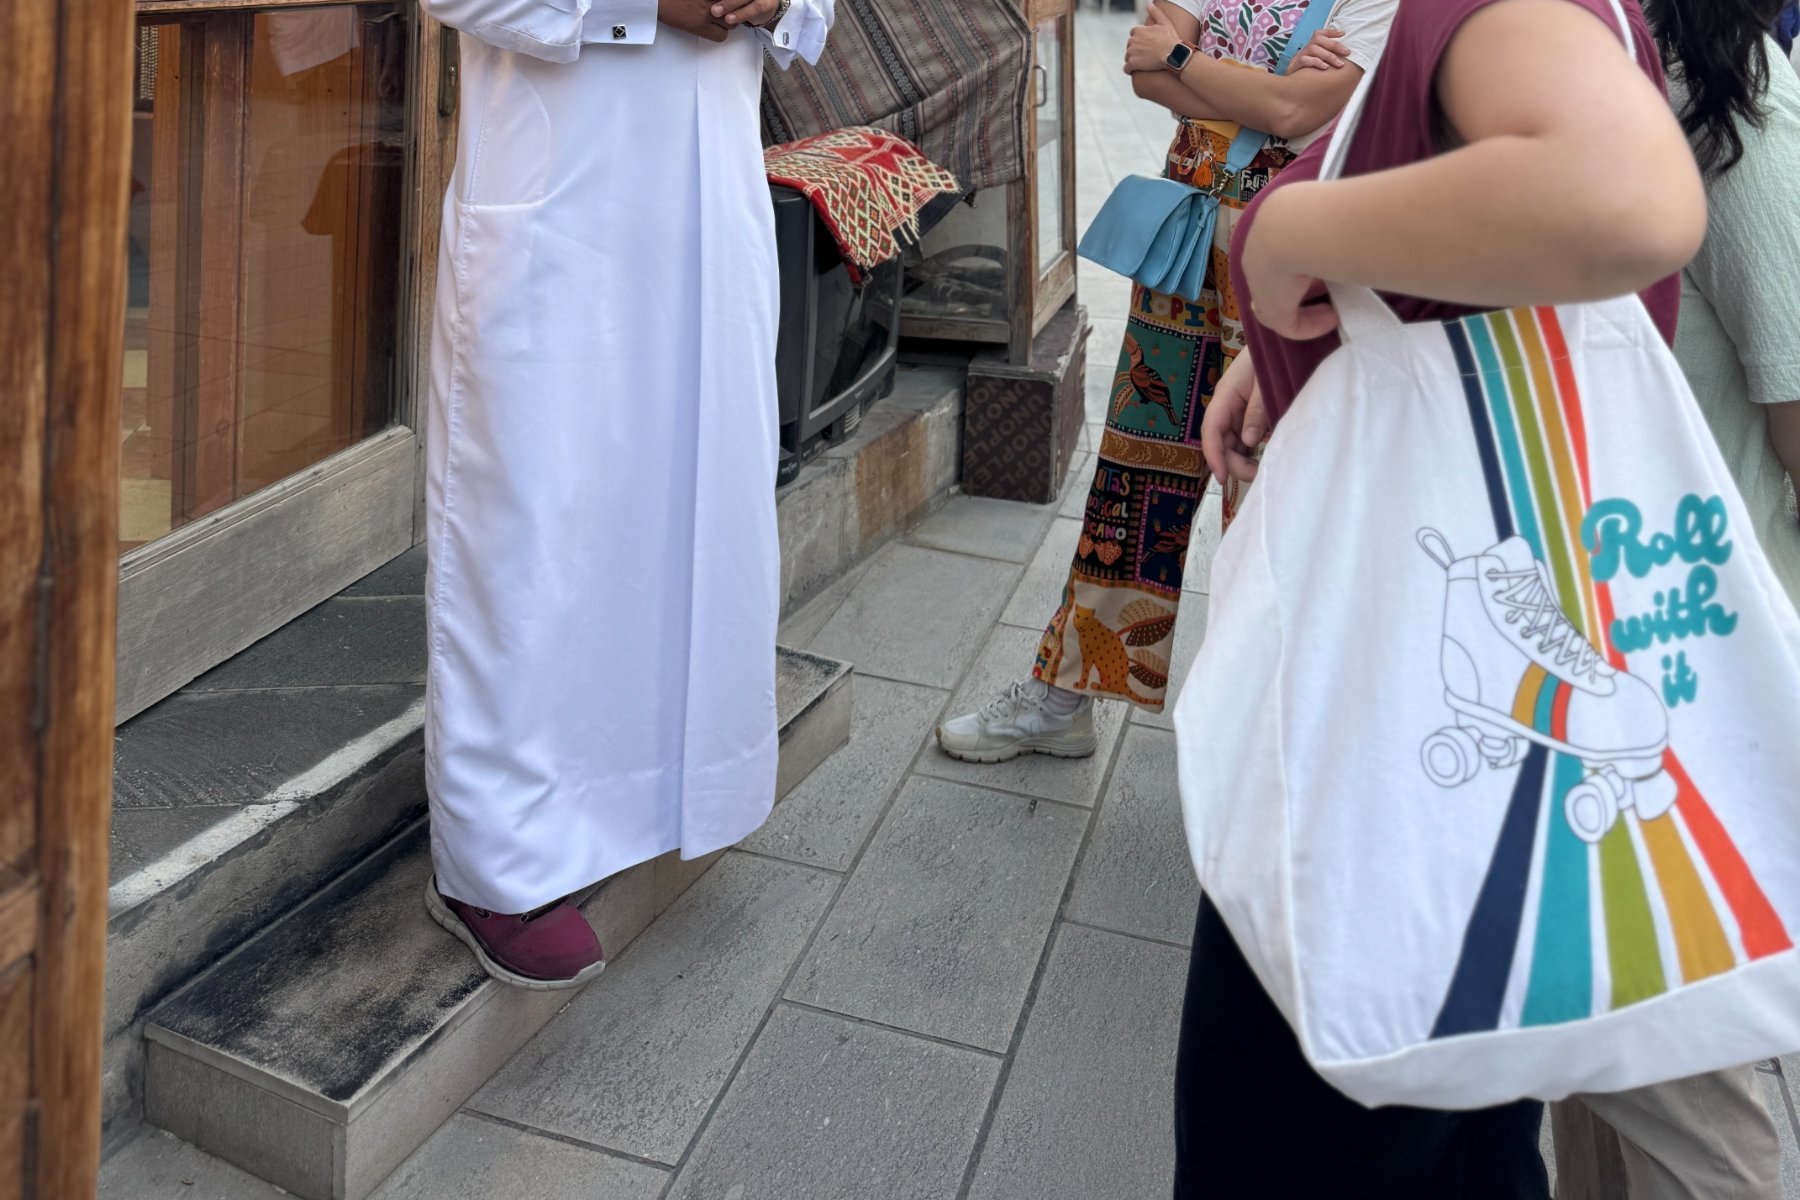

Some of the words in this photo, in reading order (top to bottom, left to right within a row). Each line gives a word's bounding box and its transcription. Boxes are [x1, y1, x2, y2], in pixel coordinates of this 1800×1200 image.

[1580, 493, 1733, 582] Roll
[1609, 564, 1738, 654] with
[1661, 650, 1697, 709] it
